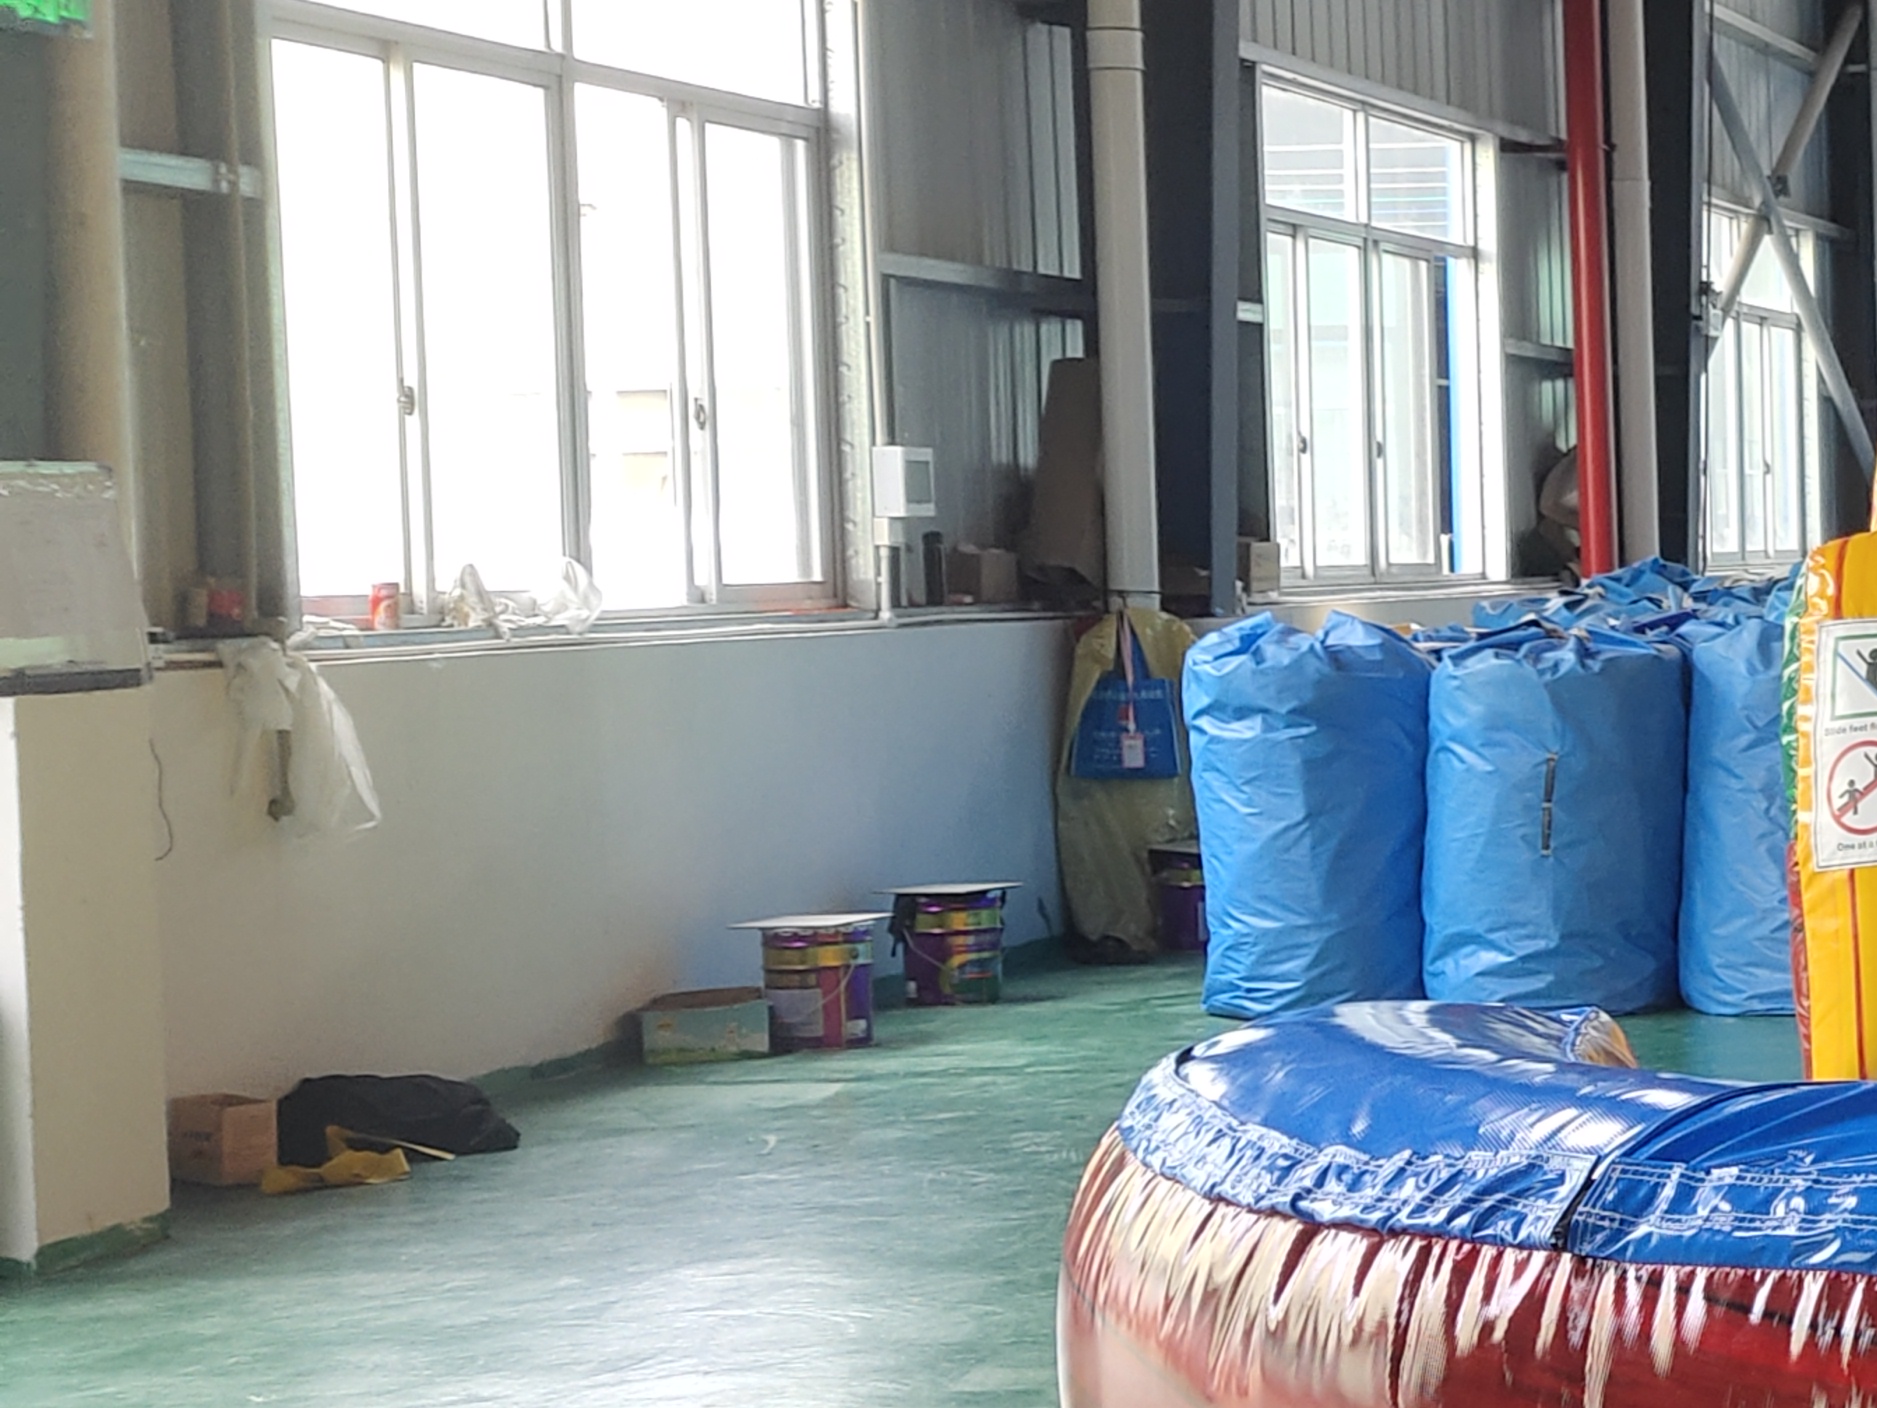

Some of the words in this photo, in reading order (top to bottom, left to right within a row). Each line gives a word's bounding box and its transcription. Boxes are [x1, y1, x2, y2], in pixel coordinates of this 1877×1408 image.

[1849, 723, 1868, 733] feet
[1837, 842, 1855, 851] One
[1857, 841, 1867, 850] at
